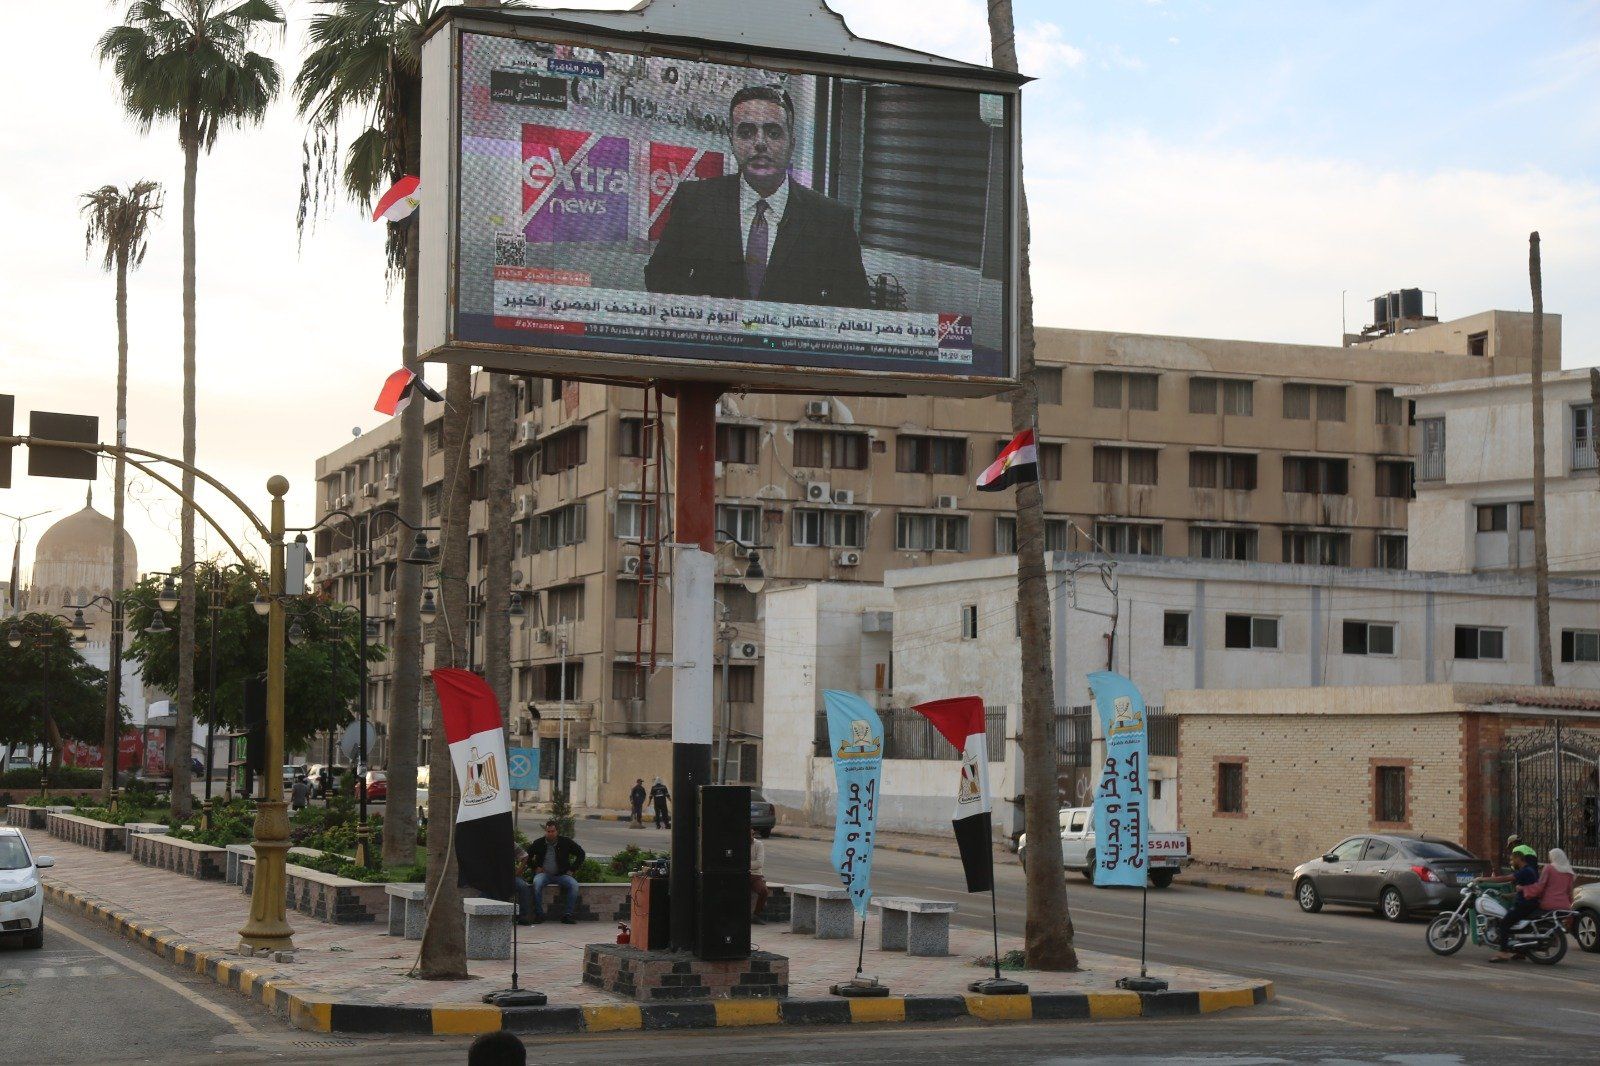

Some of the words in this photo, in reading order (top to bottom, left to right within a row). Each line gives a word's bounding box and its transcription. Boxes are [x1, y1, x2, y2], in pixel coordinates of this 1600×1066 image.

[549, 195, 608, 216] news
[503, 294, 546, 309] الكبير
[550, 299, 601, 315] المصري
[605, 301, 657, 317] المتحف
[659, 305, 703, 323] لافتتاح
[707, 310, 738, 325] اليوم
[782, 314, 825, 329] احتفال
[875, 322, 903, 335] مصر
[906, 321, 937, 338] هدية
[1101, 757, 1121, 799] مركز
[1123, 751, 1142, 795] كفر
[845, 783, 862, 827] مركز
[1106, 803, 1122, 814] و
[847, 832, 860, 842] و
[1123, 802, 1144, 869] الشيخ
[1101, 819, 1123, 870] مدينة
